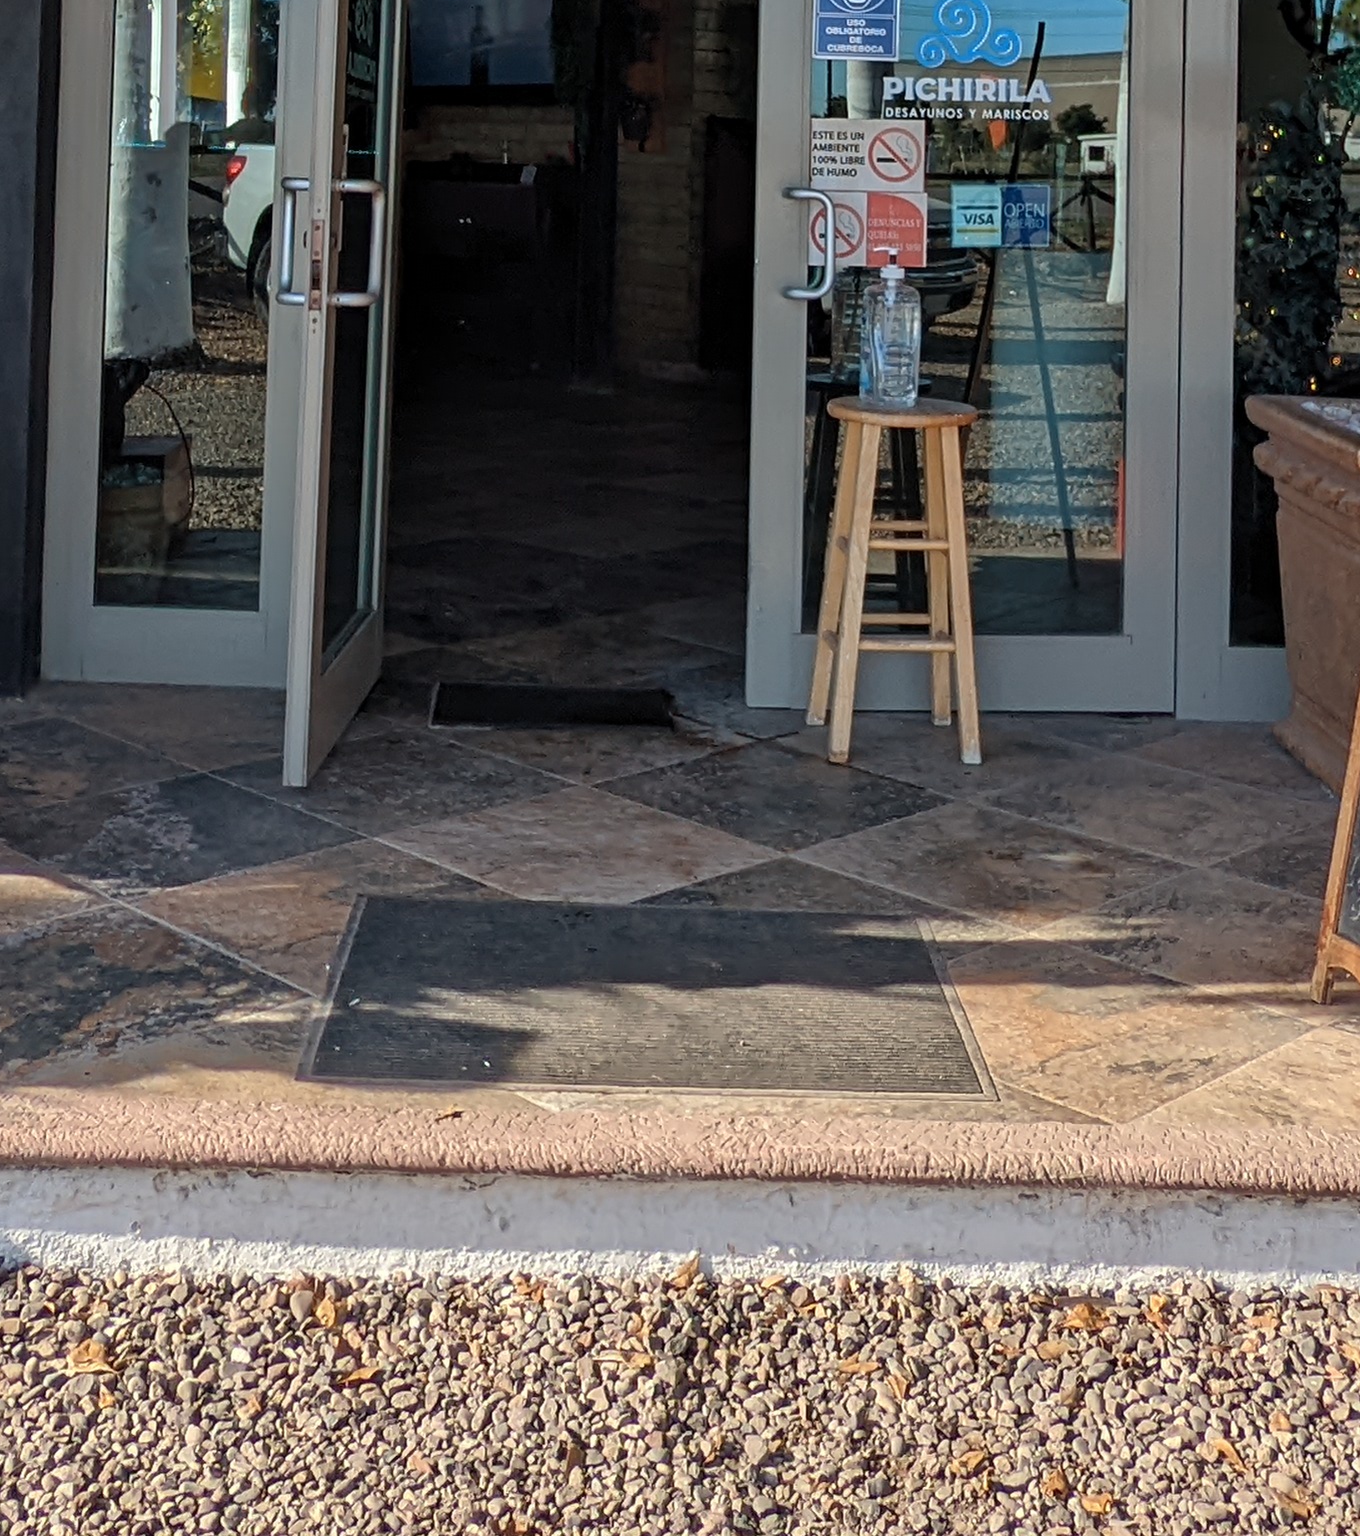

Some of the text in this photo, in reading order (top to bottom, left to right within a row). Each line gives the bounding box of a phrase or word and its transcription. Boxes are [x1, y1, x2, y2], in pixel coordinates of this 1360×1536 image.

[846, 18, 866, 27] USO
[825, 26, 887, 37] OBLIGATORIO
[848, 36, 863, 44] DE
[826, 44, 885, 54] CUBREBOCA
[882, 76, 1052, 103] PICHIRILA
[885, 107, 1050, 121] DESAYUNOS Y MARISCOS
[812, 130, 866, 141] ESTE ES UN
[812, 143, 861, 154] AMBIENTE
[812, 155, 866, 166] 100% LIBRE
[812, 167, 858, 178] DE HUMO
[1003, 202, 1046, 219] OPEN
[867, 217, 915, 228] DENUNCIAS
[963, 213, 995, 225] VISA
